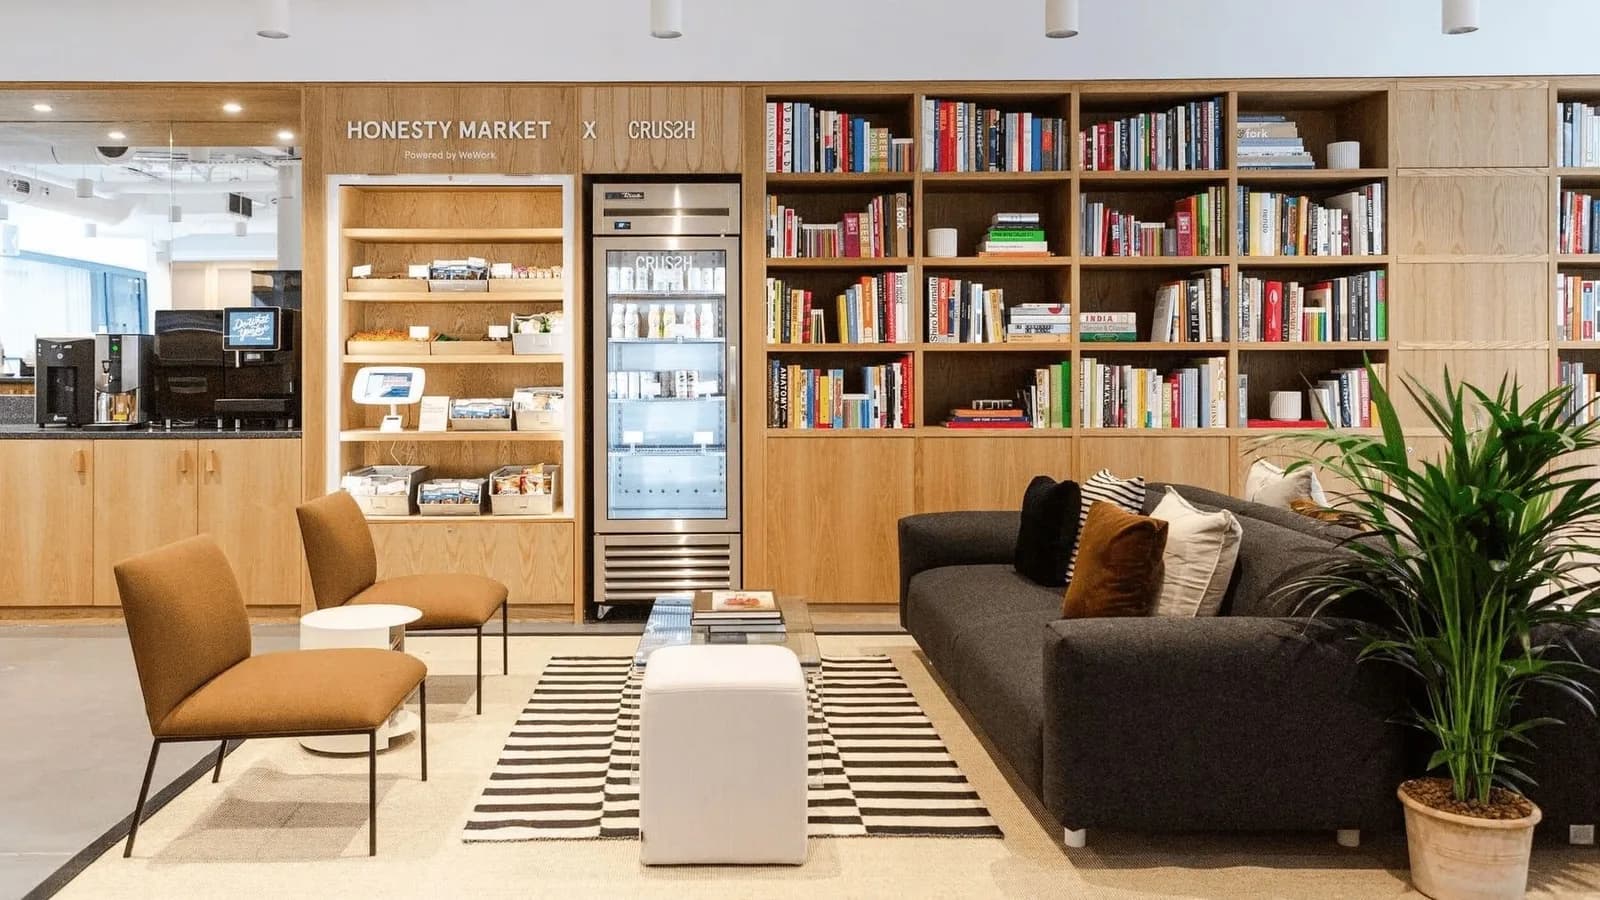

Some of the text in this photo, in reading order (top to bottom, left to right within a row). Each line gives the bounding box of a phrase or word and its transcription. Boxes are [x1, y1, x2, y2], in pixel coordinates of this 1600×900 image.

[347, 121, 551, 139] HONESTY MARKET
[583, 121, 596, 139] X
[629, 121, 695, 139] CRUSSH
[405, 150, 443, 159] Powered
[447, 150, 456, 161] by
